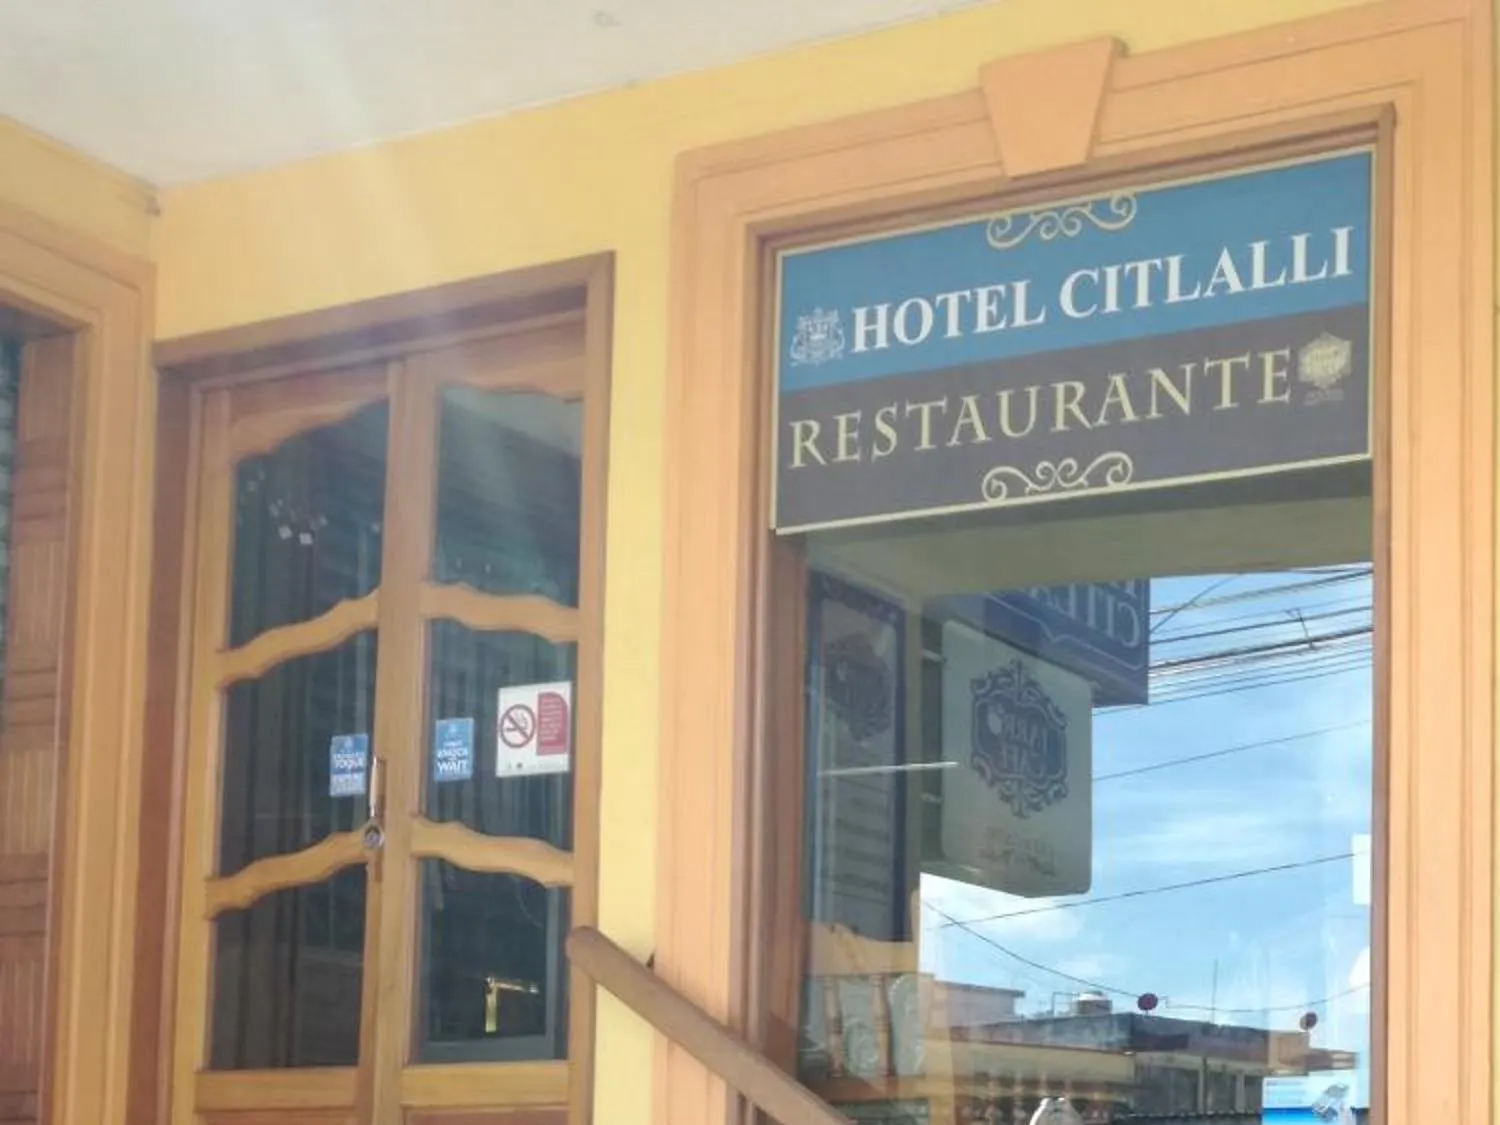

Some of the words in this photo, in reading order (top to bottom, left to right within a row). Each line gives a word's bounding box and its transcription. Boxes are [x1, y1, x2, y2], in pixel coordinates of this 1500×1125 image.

[852, 279, 1046, 354] HOTEL
[1059, 226, 1354, 319] CITLALLI
[788, 347, 1292, 470] RESTAURANTE
